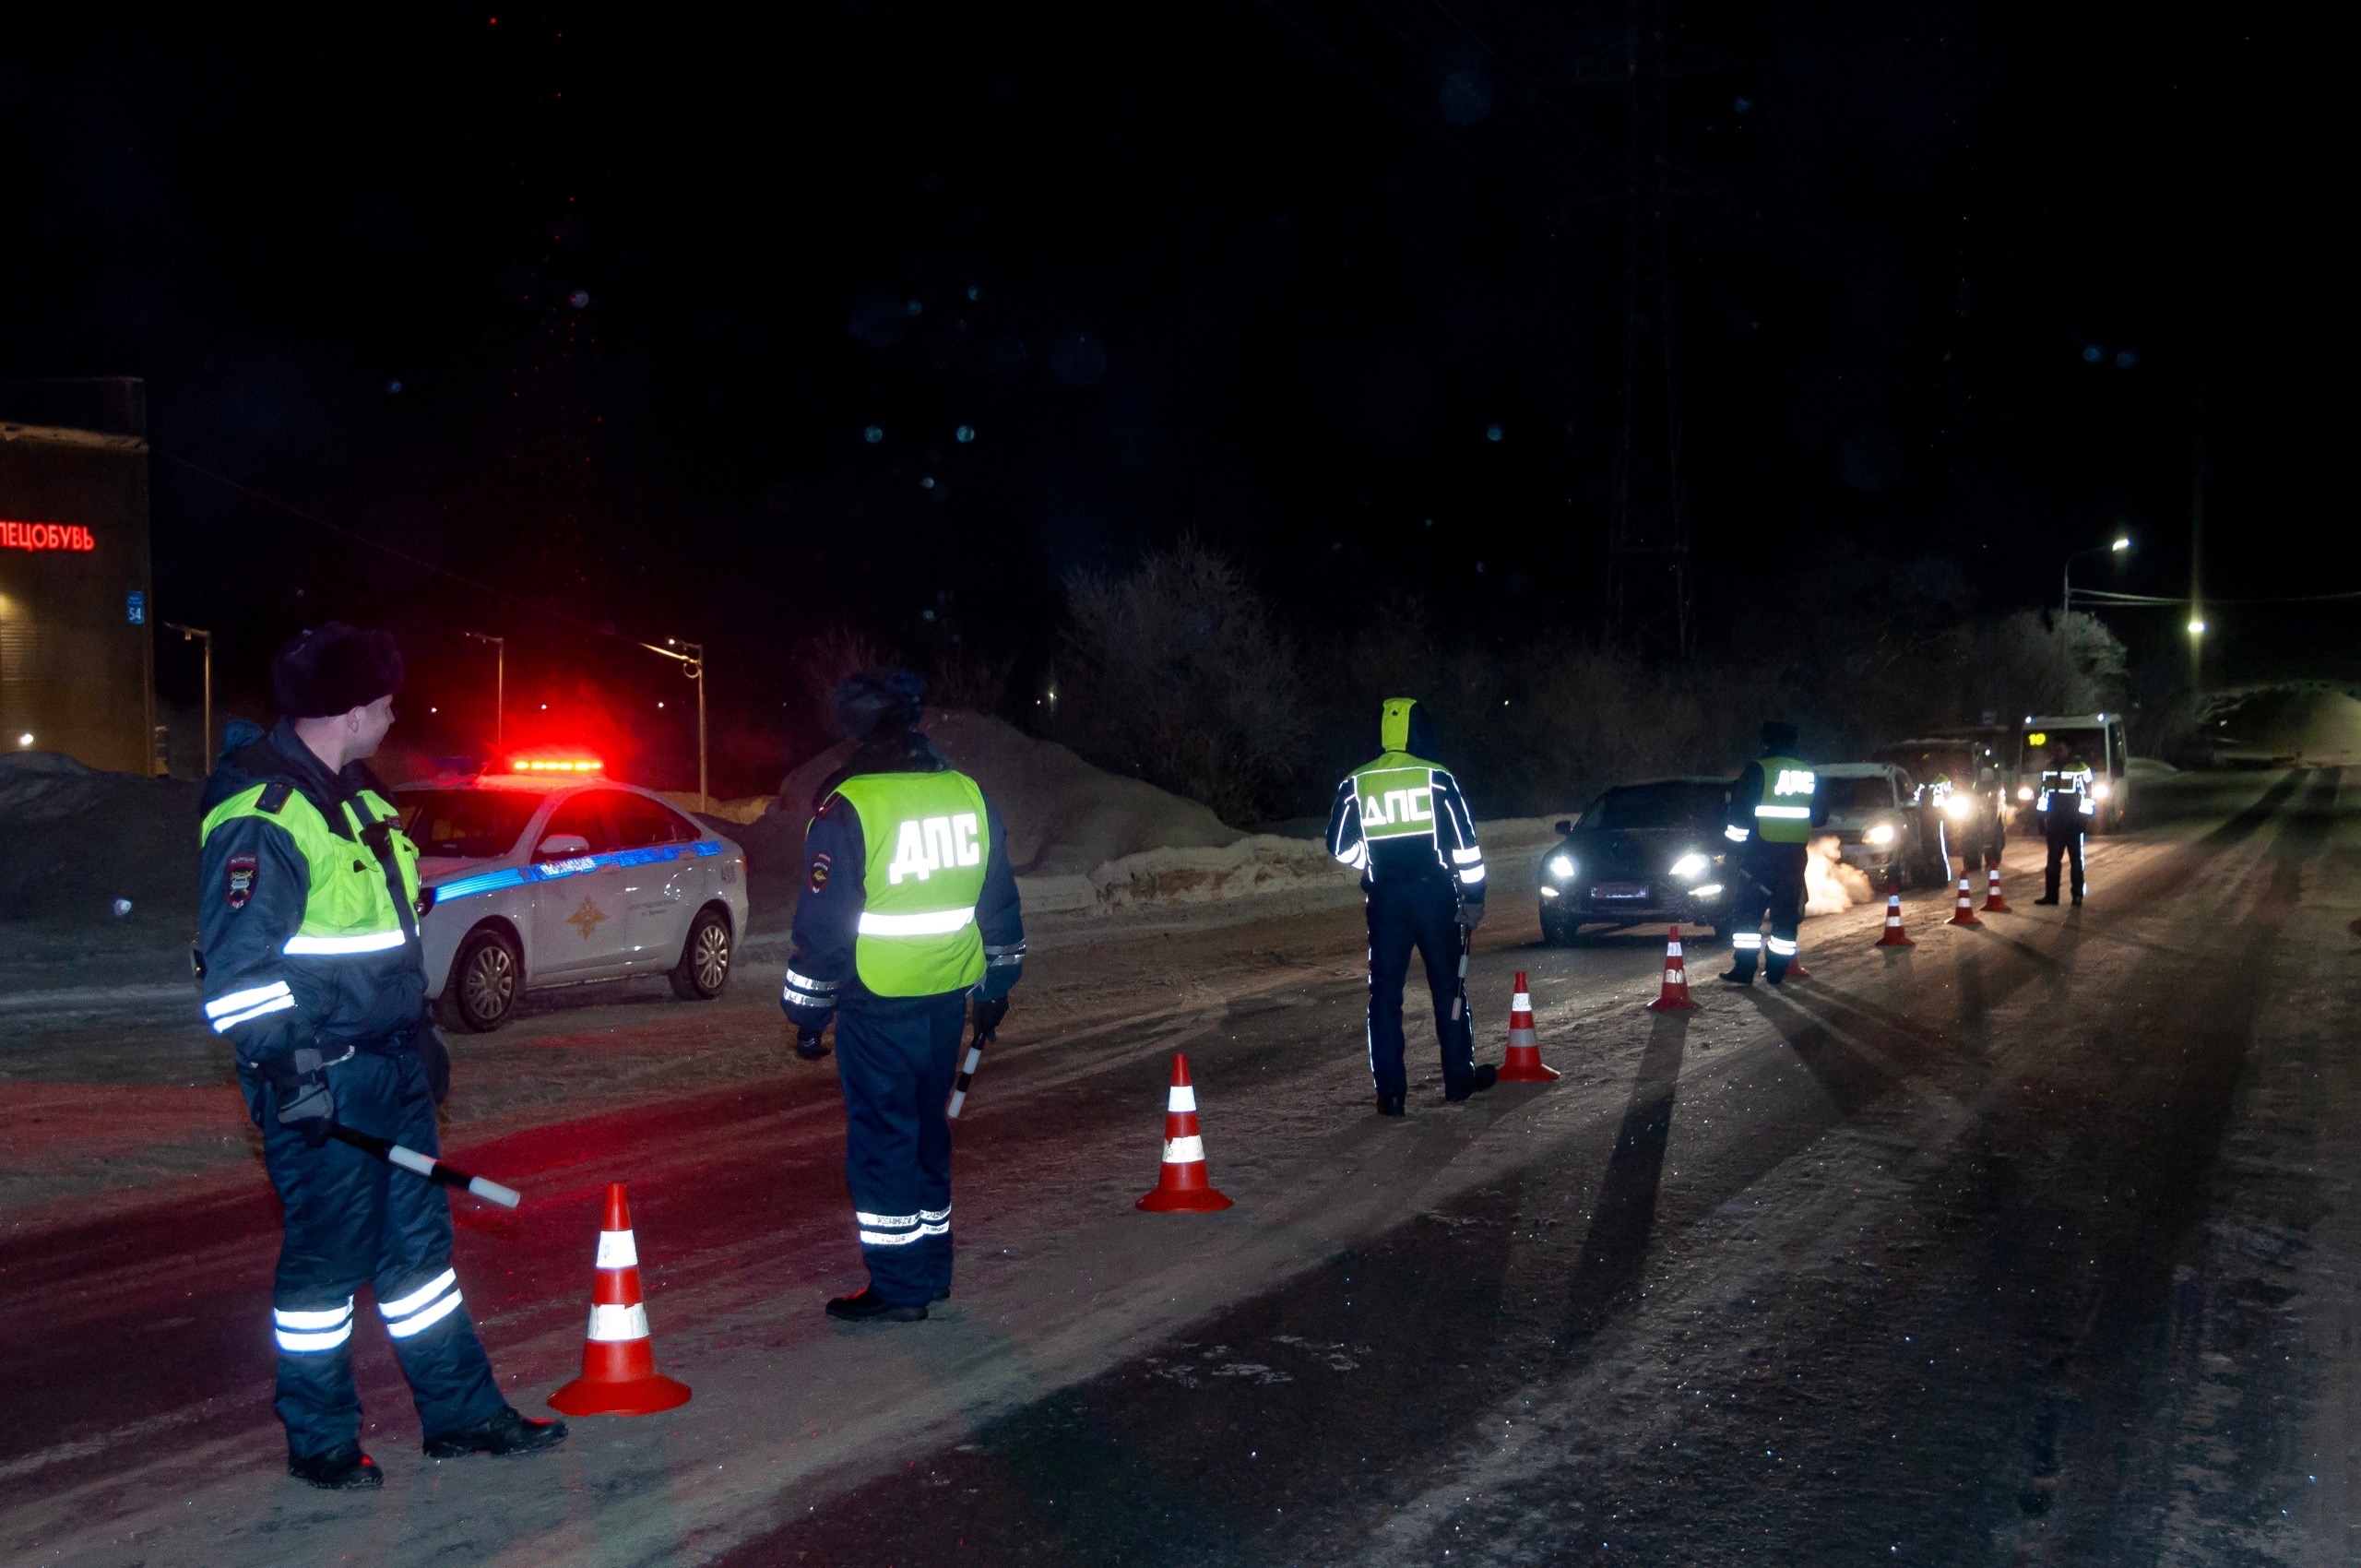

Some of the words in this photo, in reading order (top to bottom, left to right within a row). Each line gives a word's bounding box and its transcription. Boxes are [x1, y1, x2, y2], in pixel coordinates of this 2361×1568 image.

[129, 607, 141, 621] 54
[1774, 769, 1815, 796] ДПС
[1362, 787, 1432, 827] ДПС
[888, 813, 980, 885] ДПС
